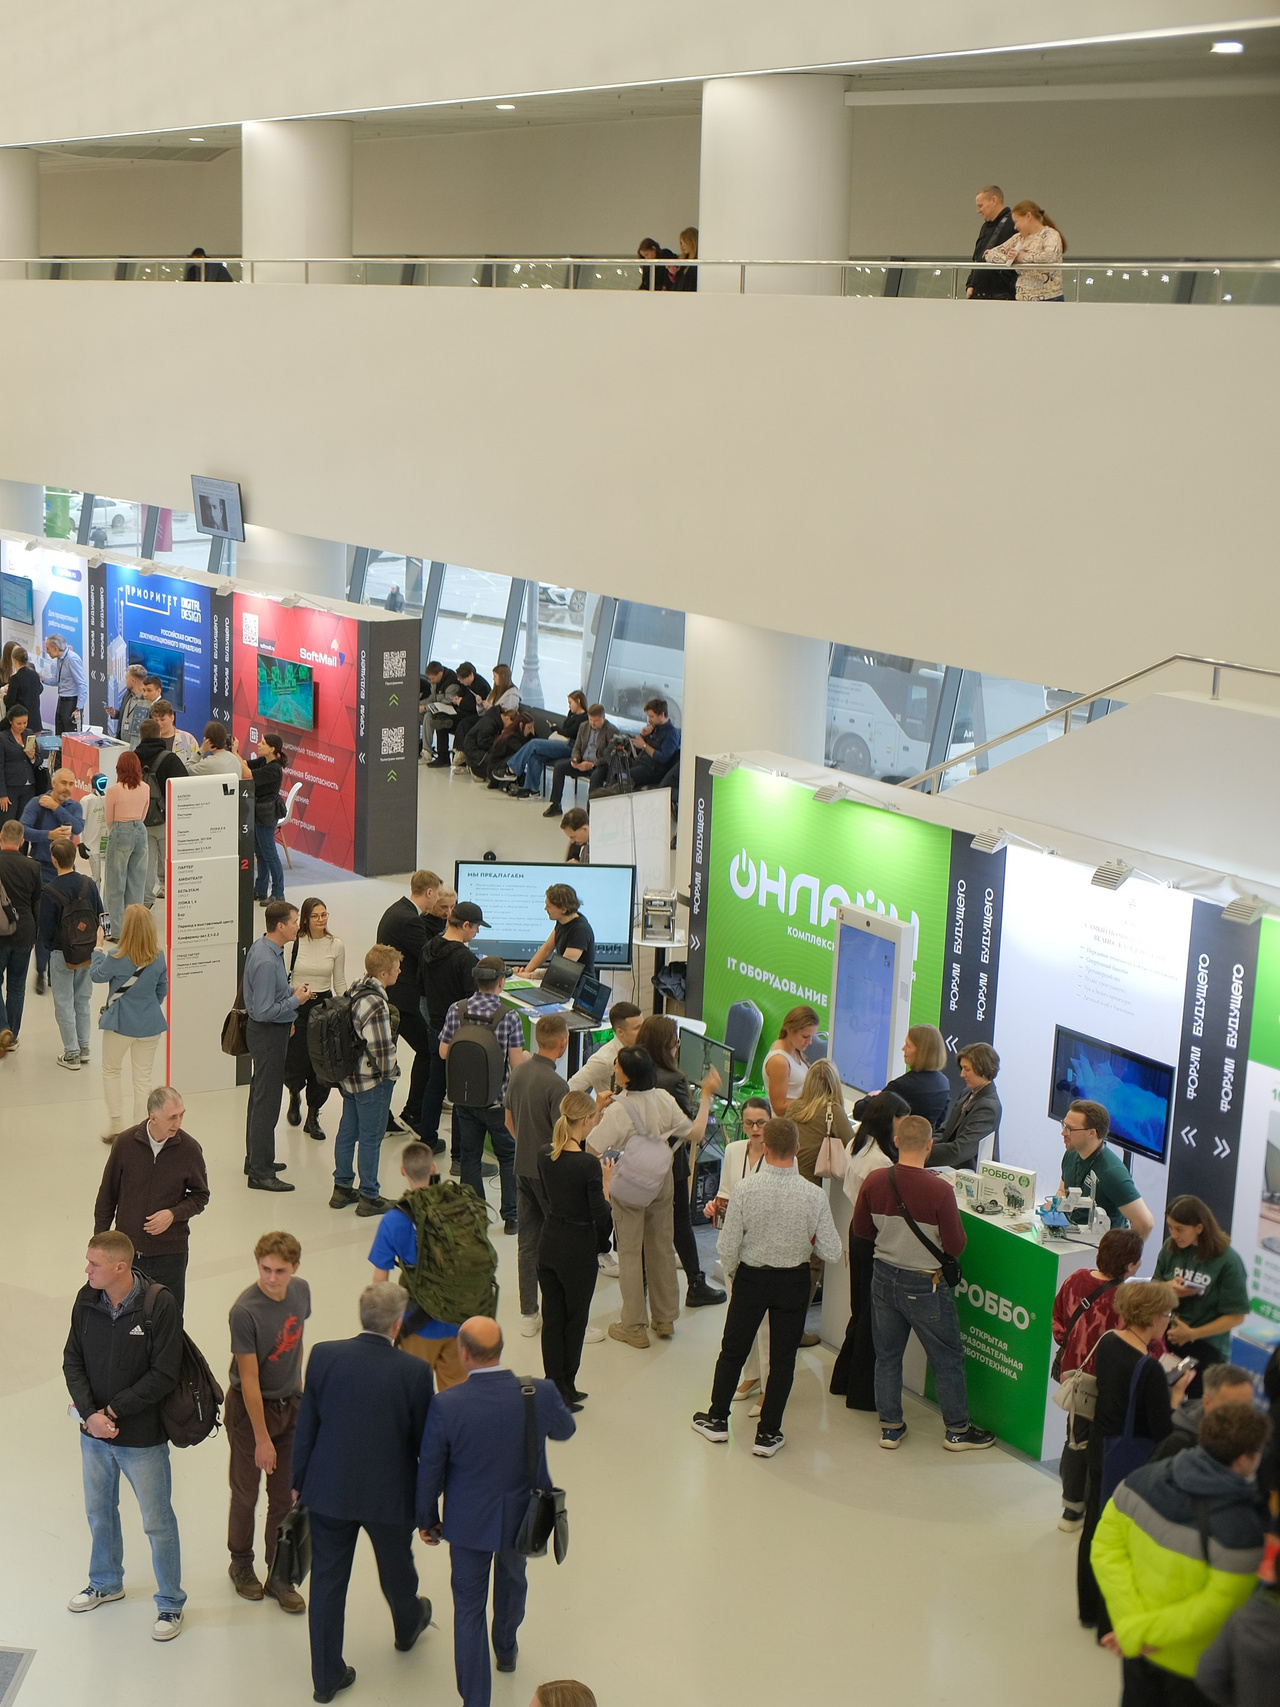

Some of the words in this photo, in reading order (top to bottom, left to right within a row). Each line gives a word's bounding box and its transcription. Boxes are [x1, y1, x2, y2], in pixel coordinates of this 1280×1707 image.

[125, 585, 177, 607] ПРИОРИТЕТ
[181, 597, 201, 612] DIGITAL
[181, 608, 201, 623] DESIGN
[299, 648, 337, 667] SoftMall
[242, 789, 249, 798] 4
[242, 824, 248, 833] 3
[241, 859, 249, 869] 2
[693, 871, 702, 915] ФОРУМ
[242, 947, 247, 956] 1
[727, 956, 737, 969] IT
[739, 961, 828, 1008] ОБОРУДОВАНИЕ
[949, 962, 961, 1012] ФОРУМ
[976, 972, 988, 1022] ФОРУМ
[1186, 1045, 1202, 1100] ФОРУМ
[1220, 1057, 1235, 1113] ФОРУМ
[956, 1173, 975, 1184] РОББО
[982, 1166, 1015, 1182] РОББО
[954, 1278, 1030, 1330] РОББО
[969, 1325, 1008, 1351] ОТКРЫТАЯ
[960, 1331, 1024, 1371] БРАЗОВАТЕЛЬНАЯ
